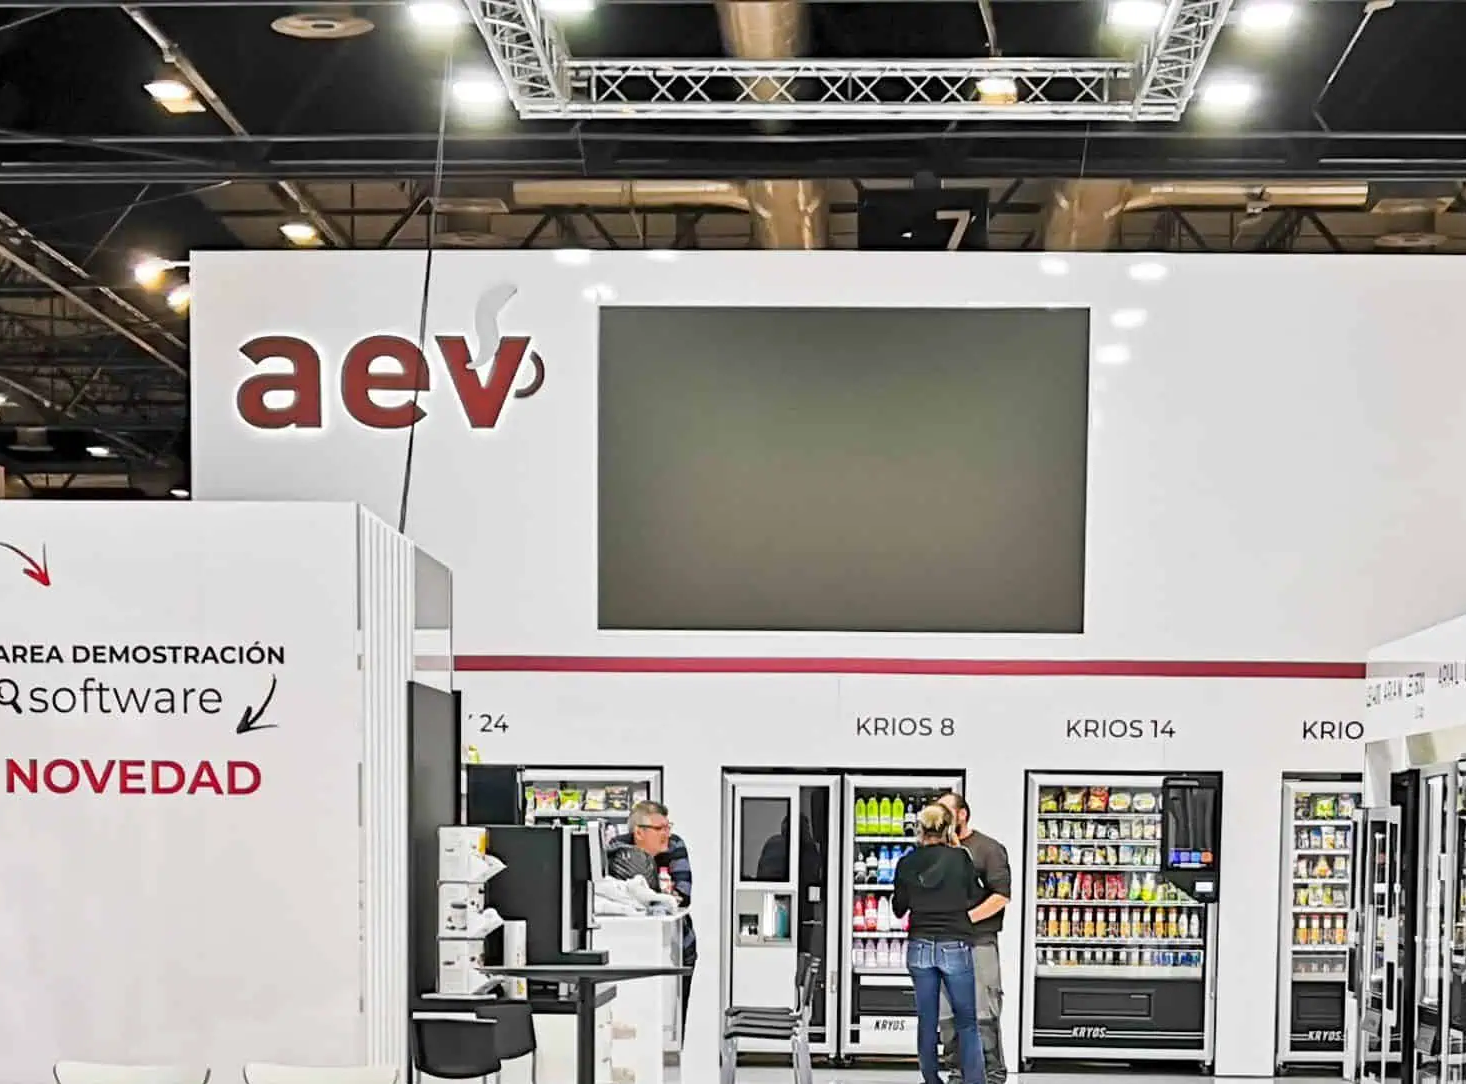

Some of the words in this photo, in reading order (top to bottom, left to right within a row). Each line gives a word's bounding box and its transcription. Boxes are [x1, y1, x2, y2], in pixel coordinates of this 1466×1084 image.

[935, 209, 971, 250] 7
[236, 333, 545, 429] aev
[72, 640, 285, 665] DEMOSTRACIÓN
[28, 677, 223, 714] software
[479, 713, 510, 734] 24
[855, 717, 933, 737] KRIOS
[939, 717, 956, 737] 8
[1066, 719, 1144, 739] KRIOS
[1150, 719, 1177, 739] 14
[1302, 720, 1365, 740] KRIO
[5, 757, 263, 796] NOVEDAD
[873, 1018, 907, 1032] KRYOS
[1072, 1025, 1108, 1039] KRYOS
